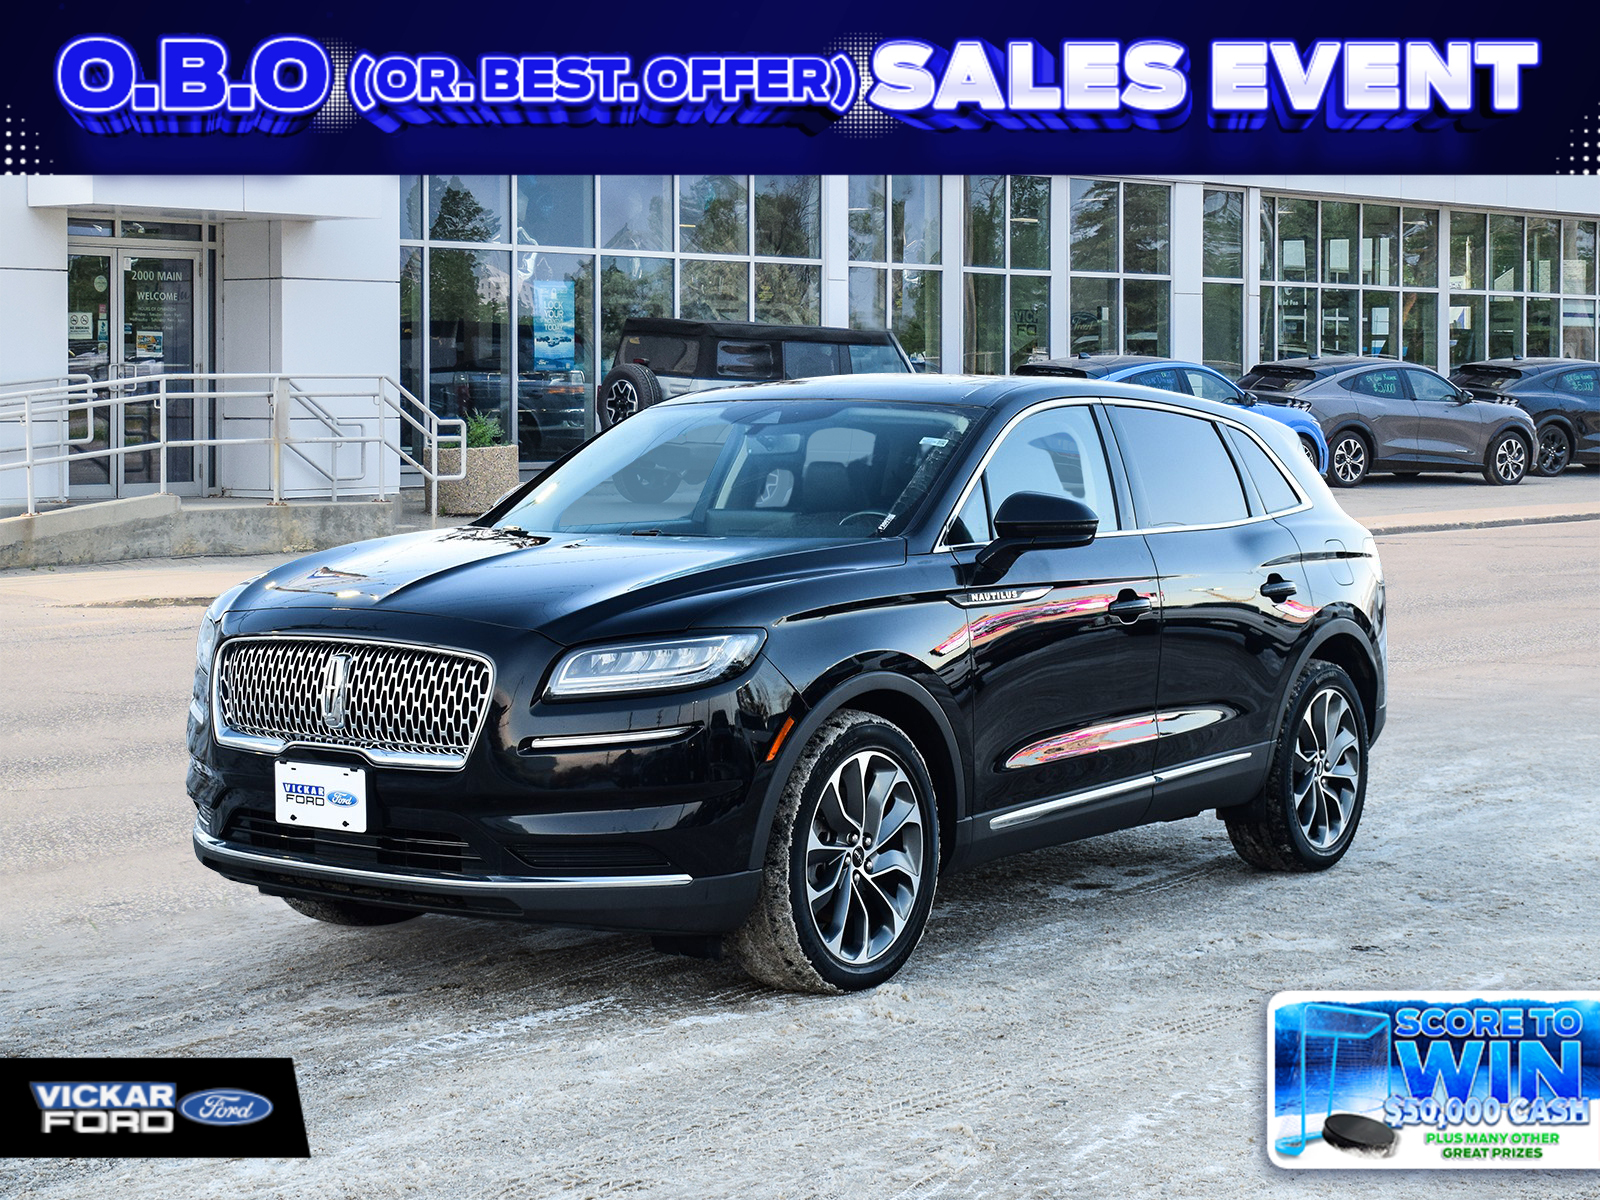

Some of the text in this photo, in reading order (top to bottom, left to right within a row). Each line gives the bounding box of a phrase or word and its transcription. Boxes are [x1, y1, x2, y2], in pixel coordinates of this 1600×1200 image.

[131, 270, 183, 282] 2000 MAIN
[136, 291, 178, 301] WELCOME
[543, 300, 563, 309] LOCK
[543, 309, 564, 318] YOUR
[971, 590, 1018, 602] NAUTILUS
[284, 783, 325, 796] VICKAR
[286, 791, 353, 807] FORD Ford
